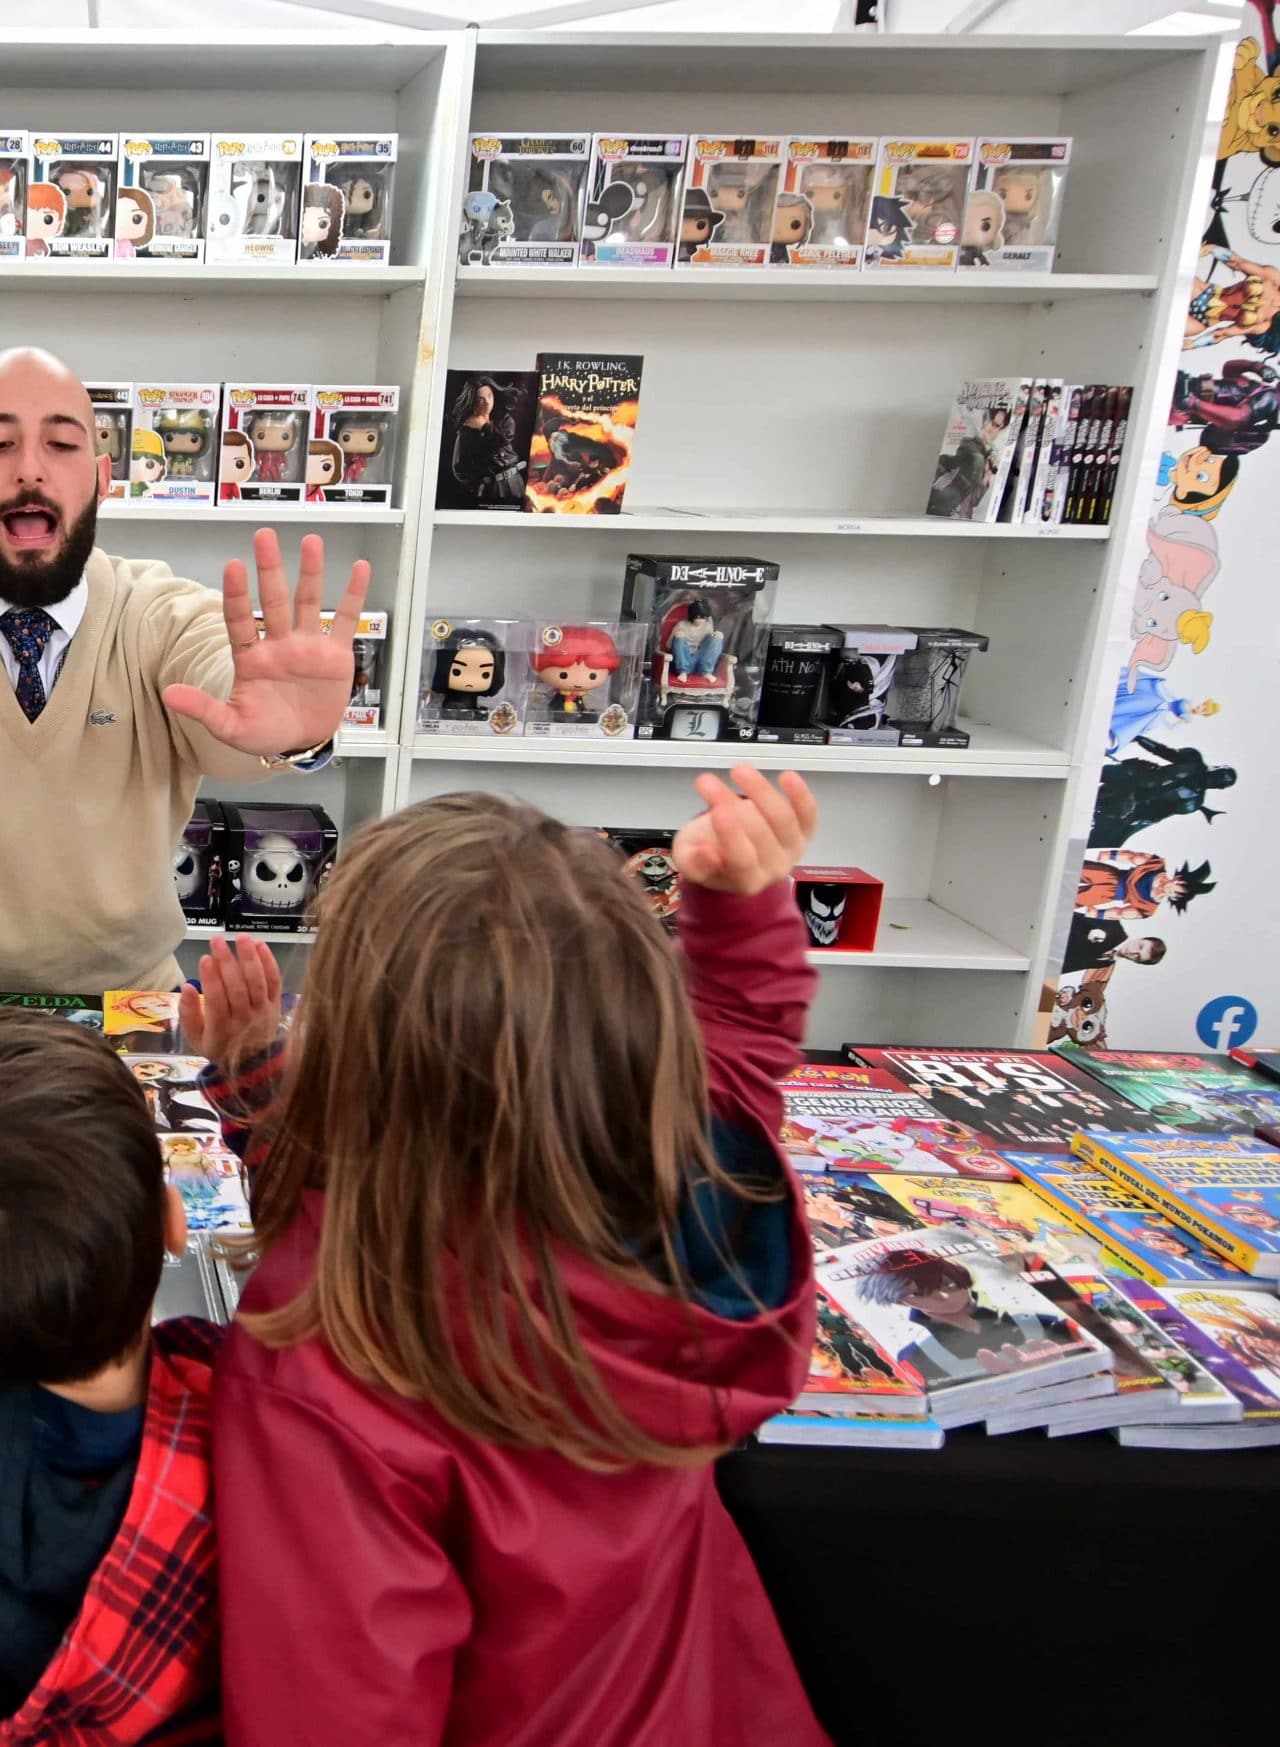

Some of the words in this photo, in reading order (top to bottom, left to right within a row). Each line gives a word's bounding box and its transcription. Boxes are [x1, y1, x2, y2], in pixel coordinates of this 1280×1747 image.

[9, 138, 22, 150] 28
[33, 141, 61, 157] POP!
[99, 141, 112, 153] 44
[124, 141, 152, 157] POP!
[190, 141, 203, 153] 43
[217, 141, 245, 157] POP!
[378, 143, 389, 154] 35
[571, 141, 584, 151] 60
[600, 140, 629, 156] POP!
[245, 243, 274, 252] HEDWIG
[499, 247, 528, 258] MOUNTED
[528, 248, 548, 258] WHITE
[549, 248, 573, 258] WALKER
[1002, 252, 1033, 260] GERALT
[575, 361, 627, 371] ROWLING
[541, 374, 587, 393] HARRY
[586, 373, 639, 393] POTTER
[138, 390, 166, 404] POP!
[168, 391, 198, 400] STRANGER
[292, 393, 306, 404] 743
[379, 394, 393, 406] 741
[169, 486, 195, 495] DUSTIN
[259, 487, 281, 496] BERLIN
[368, 622, 381, 631] 132
[740, 728, 753, 738] 06
[903, 1061, 1066, 1091] BTS
[797, 1105, 935, 1118] SINGULARES
[1118, 1169, 1146, 1192] VISUAL
[1145, 1187, 1160, 1204] DEL
[1161, 1199, 1193, 1225] MUNDO
